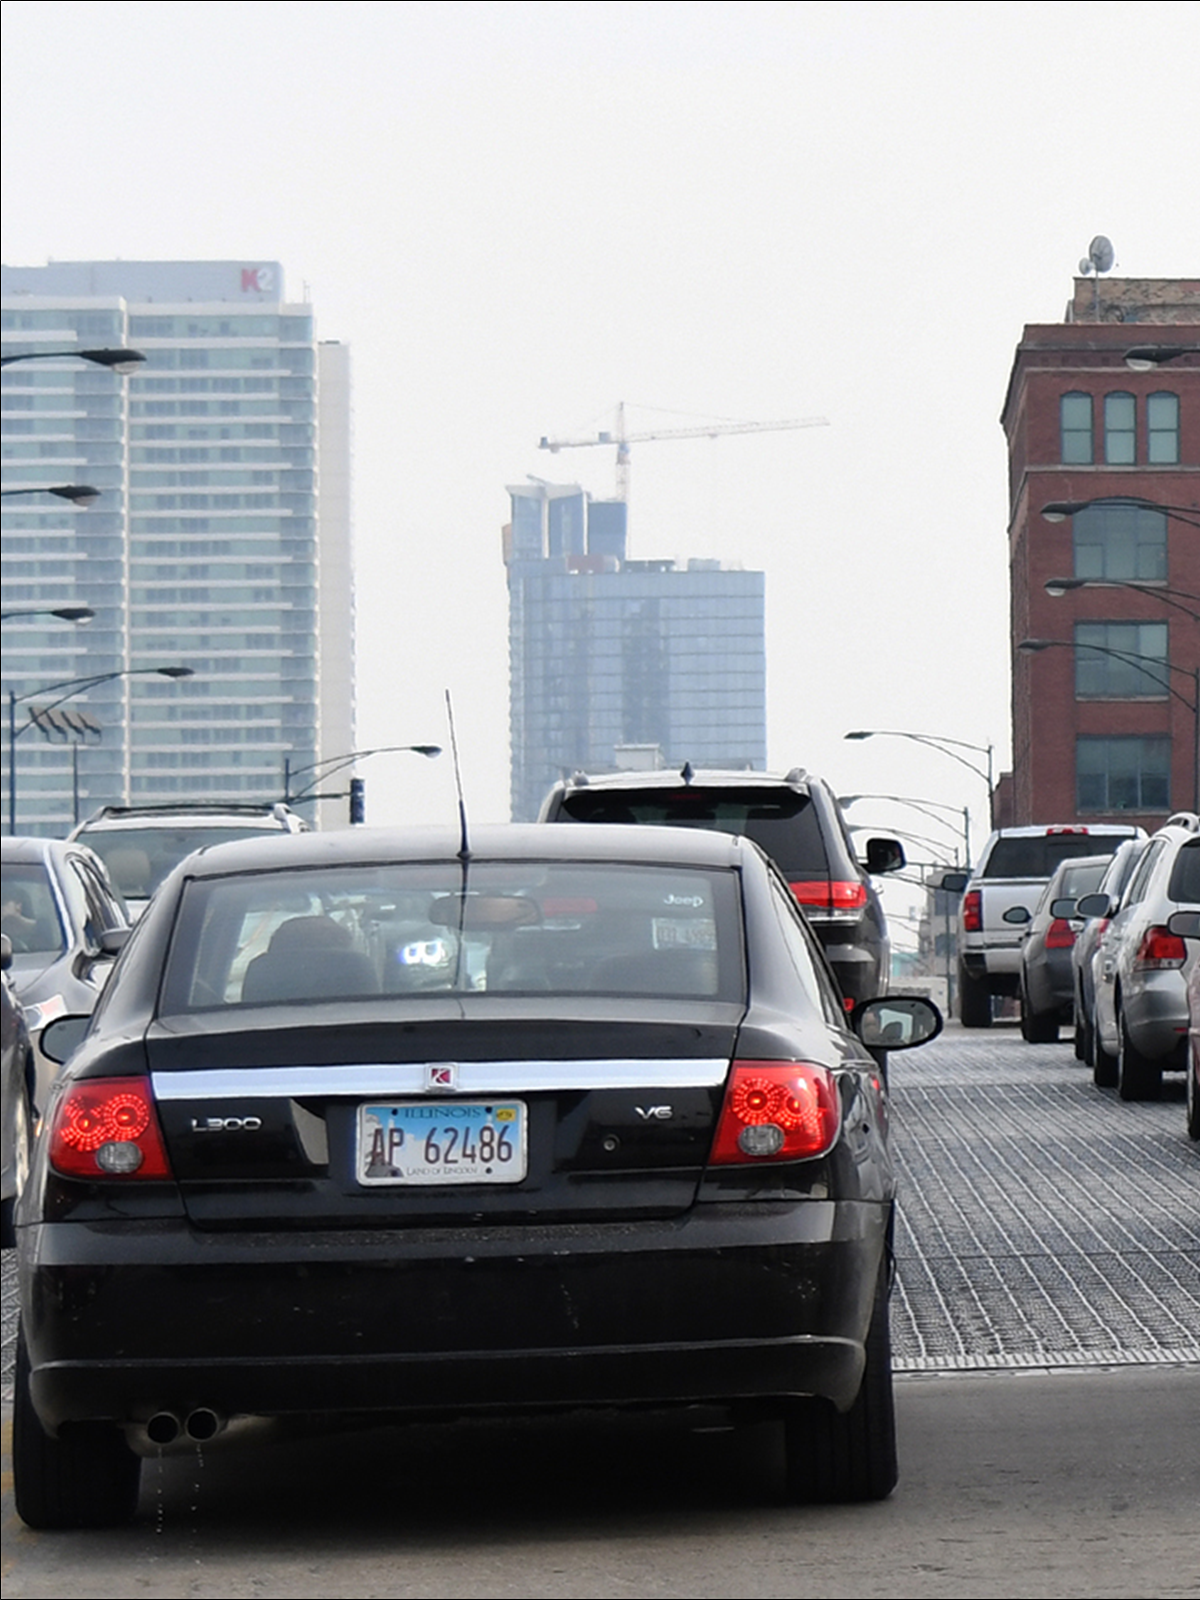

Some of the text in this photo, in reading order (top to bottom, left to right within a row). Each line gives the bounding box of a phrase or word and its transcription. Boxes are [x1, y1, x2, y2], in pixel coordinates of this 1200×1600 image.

[241, 267, 274, 292] K2
[663, 894, 704, 908] Jeep
[404, 1107, 482, 1119] ILLINOIS
[635, 1105, 673, 1120] V6
[191, 1117, 262, 1132] L300
[371, 1124, 513, 1166] AP 62486
